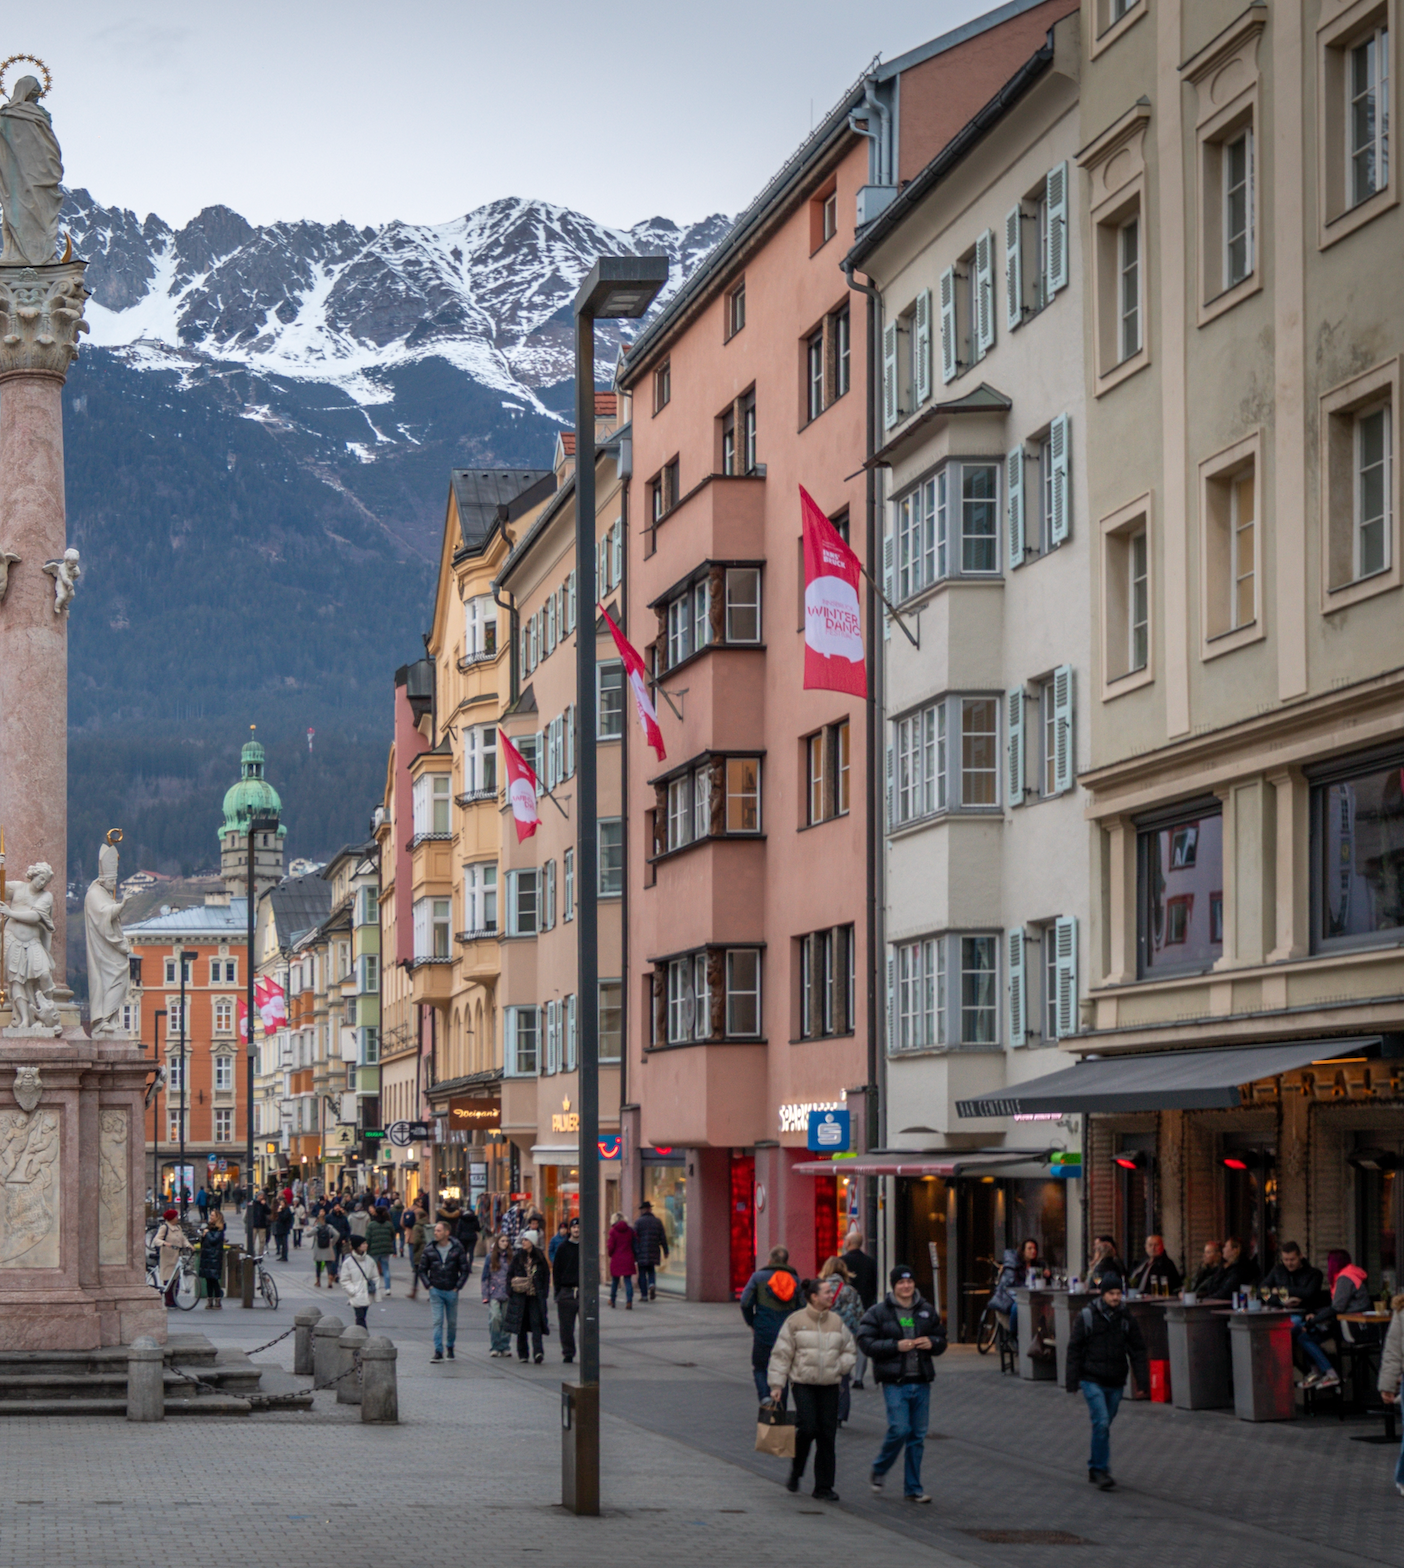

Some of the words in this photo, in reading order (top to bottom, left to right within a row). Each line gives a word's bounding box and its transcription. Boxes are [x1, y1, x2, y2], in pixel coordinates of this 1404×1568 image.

[807, 605, 858, 625] WINTER
[959, 1101, 976, 1117] BAR
[978, 1099, 1022, 1116] CENTRALE
